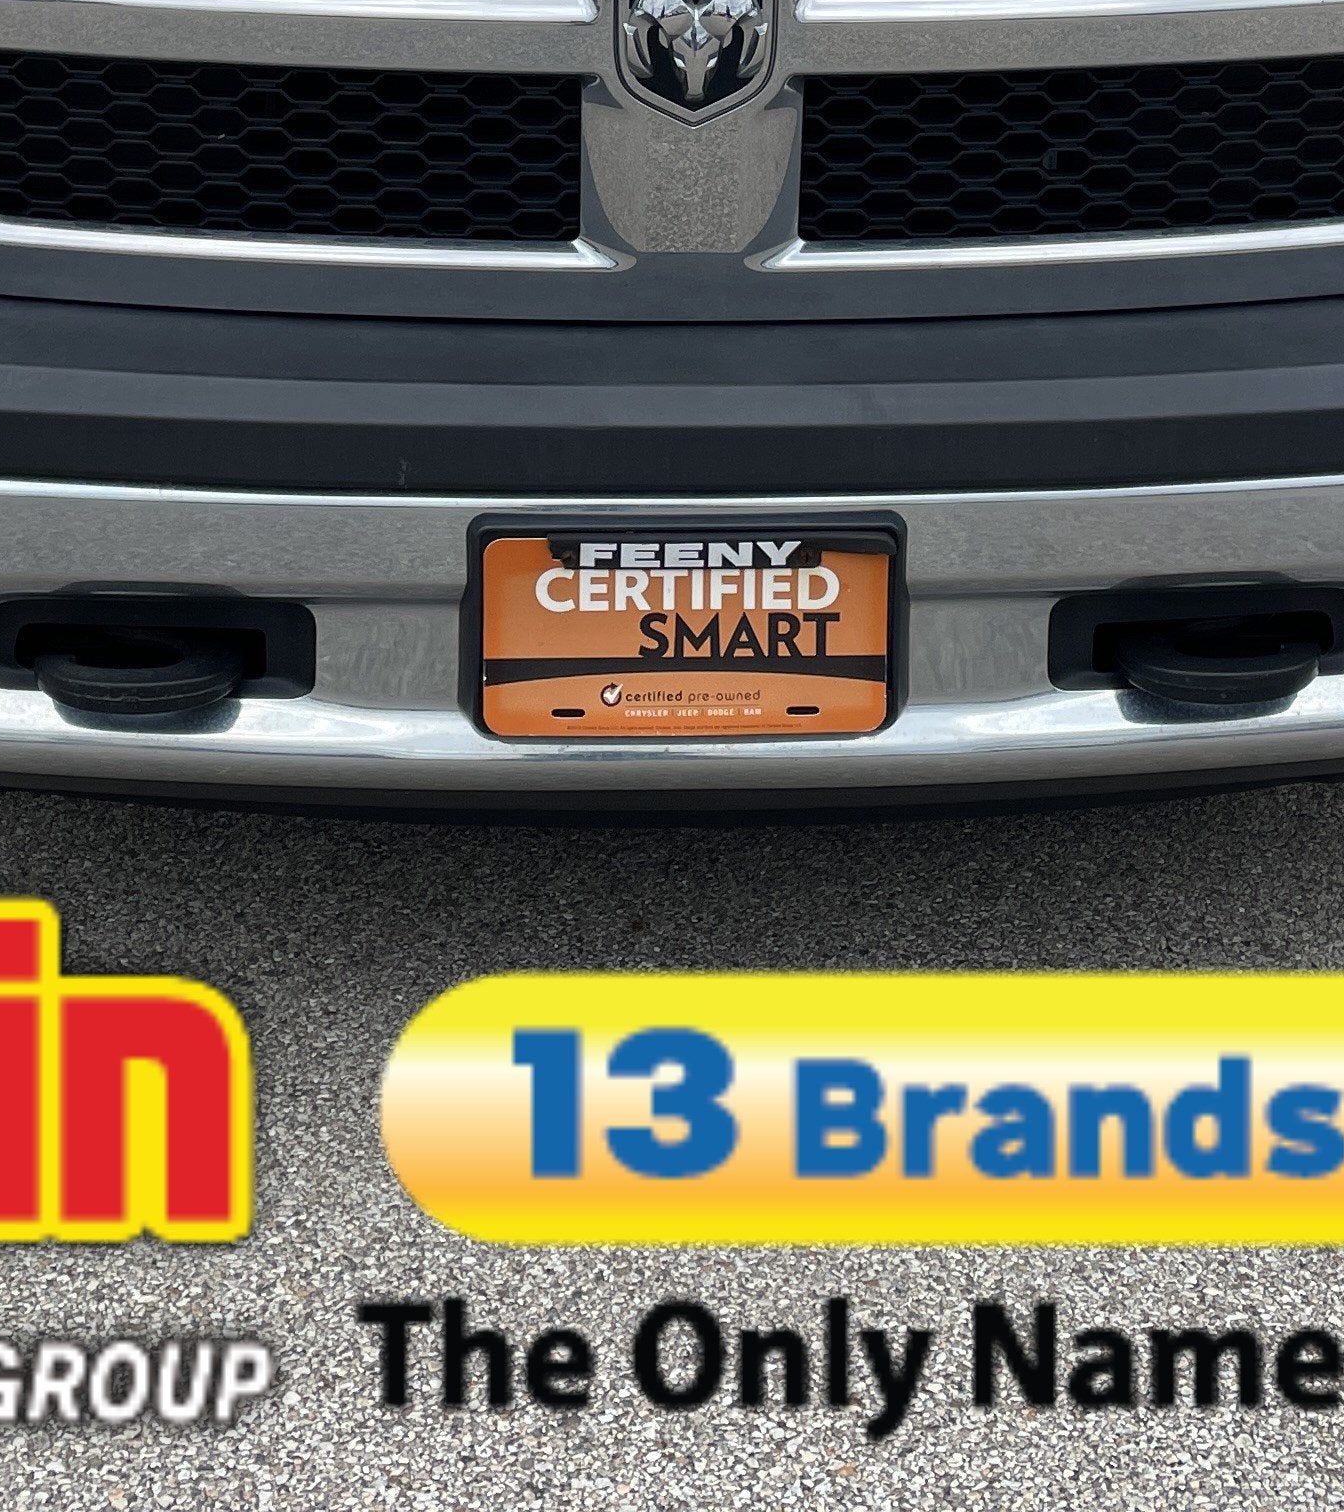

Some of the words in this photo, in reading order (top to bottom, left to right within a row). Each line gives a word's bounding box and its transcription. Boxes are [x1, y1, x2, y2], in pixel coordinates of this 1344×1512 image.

[578, 540, 803, 568] FEENY
[534, 566, 842, 612] CERTIFIED
[638, 611, 841, 659] SMART
[625, 690, 683, 702] certified
[687, 689, 761, 704] pre-owned
[624, 709, 669, 718] CHRYSLER
[677, 709, 699, 717] JEEP
[707, 708, 735, 717] DODGE
